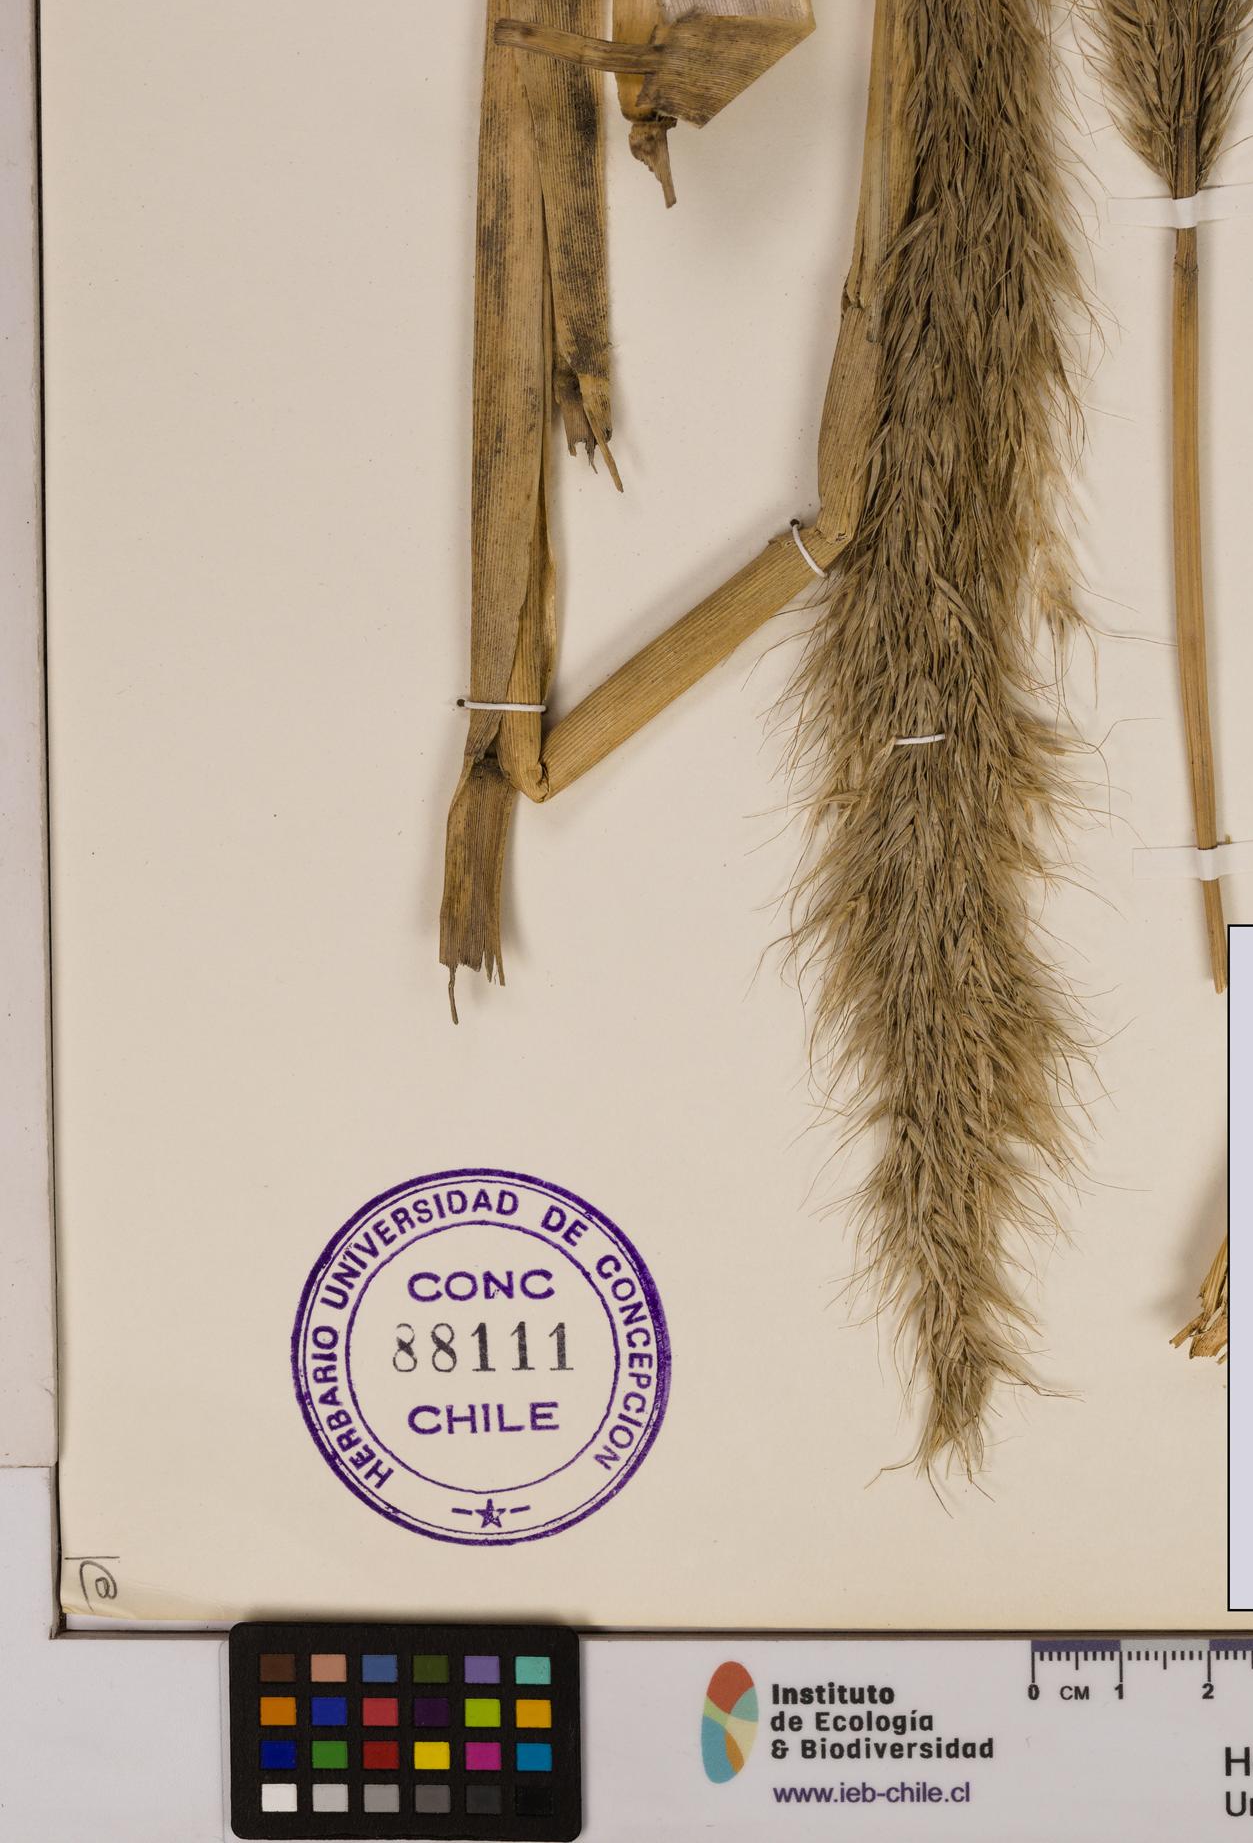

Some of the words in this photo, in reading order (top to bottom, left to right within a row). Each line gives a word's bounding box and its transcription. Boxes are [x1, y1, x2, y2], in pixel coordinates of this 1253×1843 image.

[541, 1205, 589, 1247] DE
[321, 1189, 520, 1311] UNIVERSIDAD
[408, 1269, 554, 1302] CONC
[393, 1321, 573, 1372] 88111
[594, 1255, 654, 1470] CONCEPCION
[312, 1325, 395, 1490] HERBARIO
[408, 1402, 559, 1434] CHILE
[773, 1682, 894, 1704] Instituto
[1028, 1684, 1039, 1701] 0
[1059, 1686, 1090, 1701] CM
[1115, 1684, 1124, 1700] 1
[1202, 1684, 1213, 1700] 2
[771, 1710, 803, 1732] de
[816, 1710, 934, 1738] Ecología
[771, 1739, 789, 1759] &
[801, 1737, 993, 1759] Biodiversidad
[773, 1782, 969, 1803] www.ieb-chile.cl
